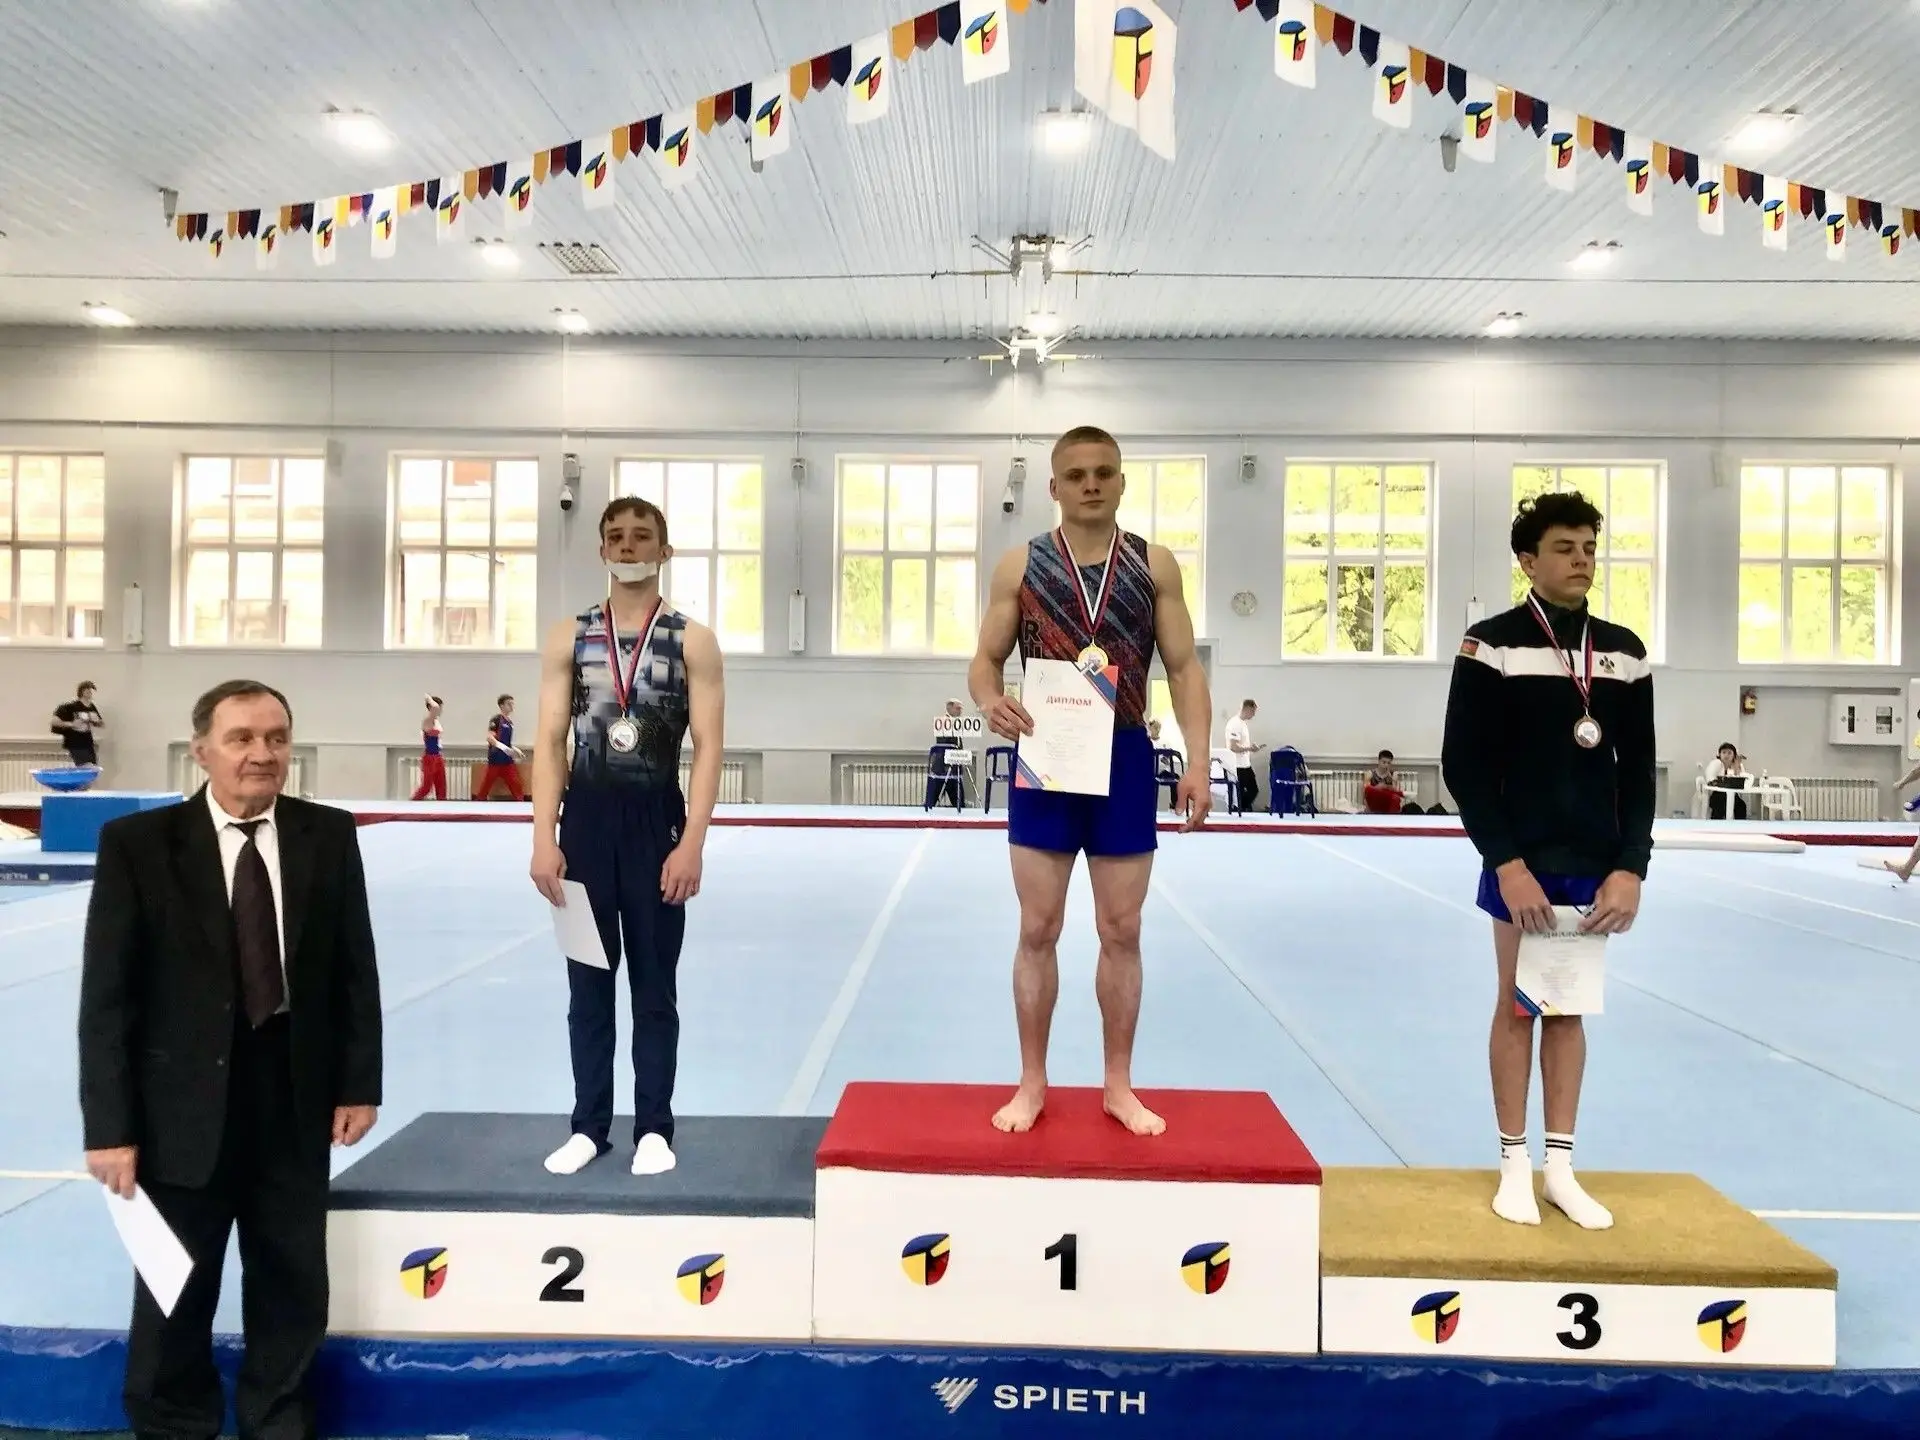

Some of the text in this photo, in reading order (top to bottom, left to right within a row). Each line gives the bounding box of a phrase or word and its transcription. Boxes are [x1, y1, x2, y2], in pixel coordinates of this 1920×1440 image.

[539, 1246, 585, 1302] 2
[1044, 1233, 1077, 1291] 1
[1556, 1292, 1602, 1350] 3
[993, 1384, 1146, 1415] SPIETH
